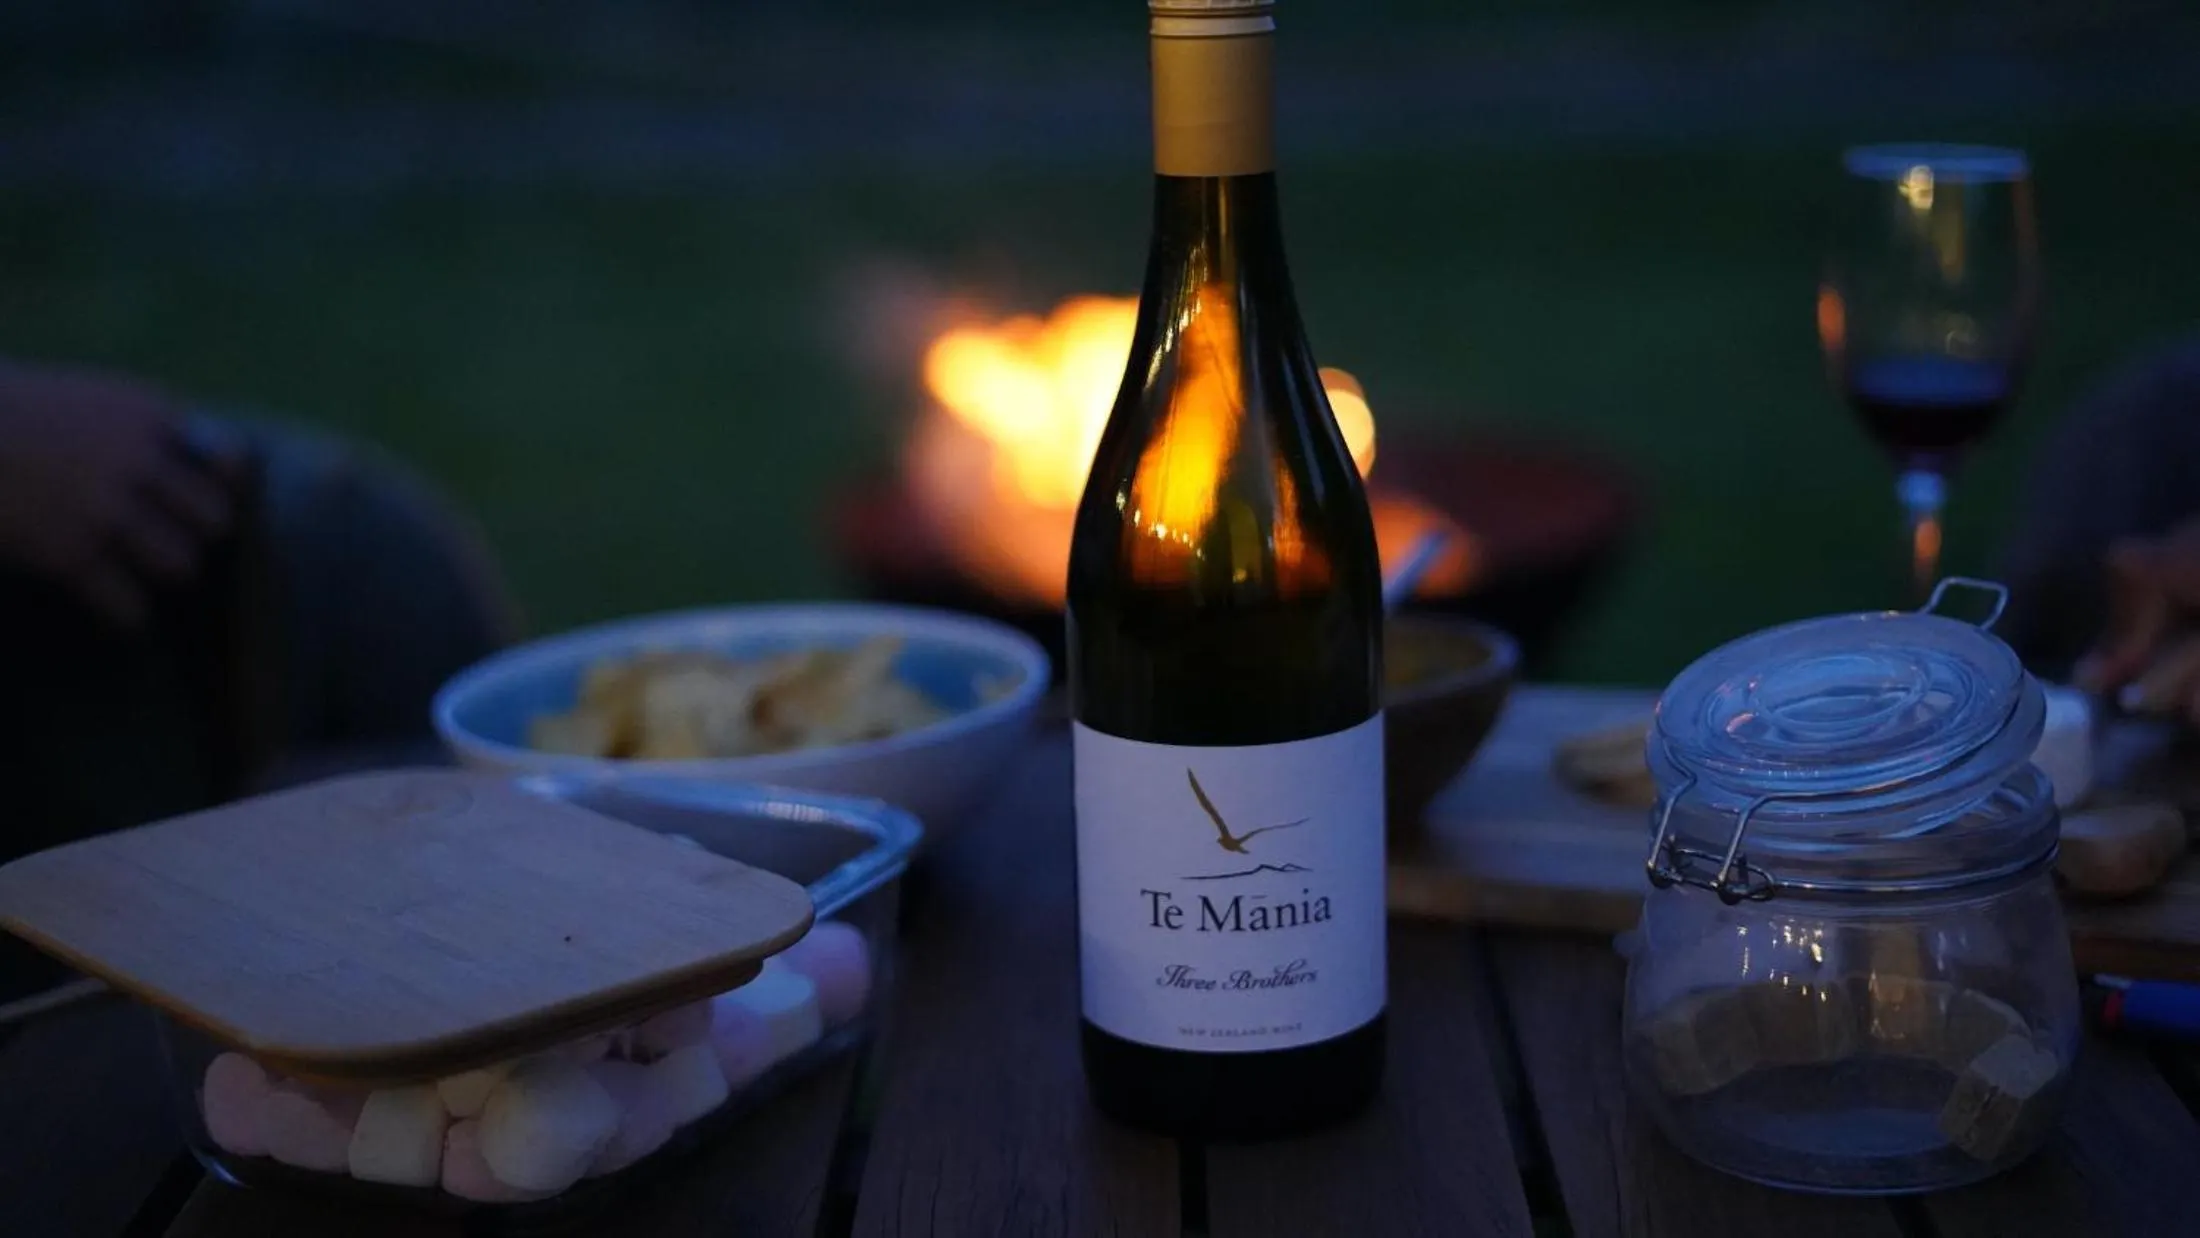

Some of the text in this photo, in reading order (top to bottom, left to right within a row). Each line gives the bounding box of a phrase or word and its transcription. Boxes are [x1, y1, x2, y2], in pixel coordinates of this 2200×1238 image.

[1140, 888, 1332, 933] Te Mānia
[1156, 958, 1319, 992] Three Brothers
